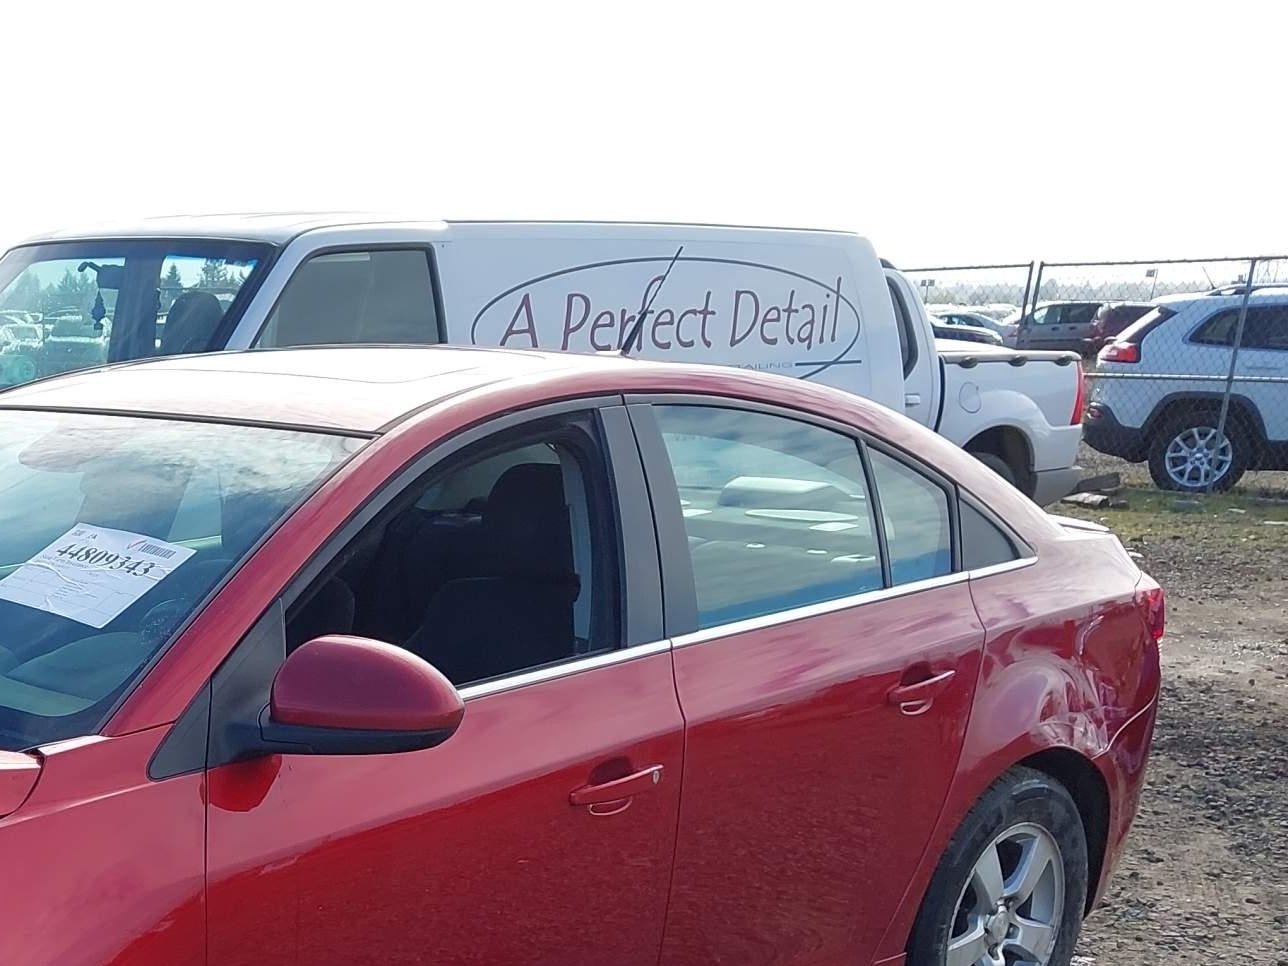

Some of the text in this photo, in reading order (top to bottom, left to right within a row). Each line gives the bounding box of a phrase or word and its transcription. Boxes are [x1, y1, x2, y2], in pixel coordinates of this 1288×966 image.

[500, 274, 842, 352] A Perfect Detail
[57, 544, 155, 577] 44809343
